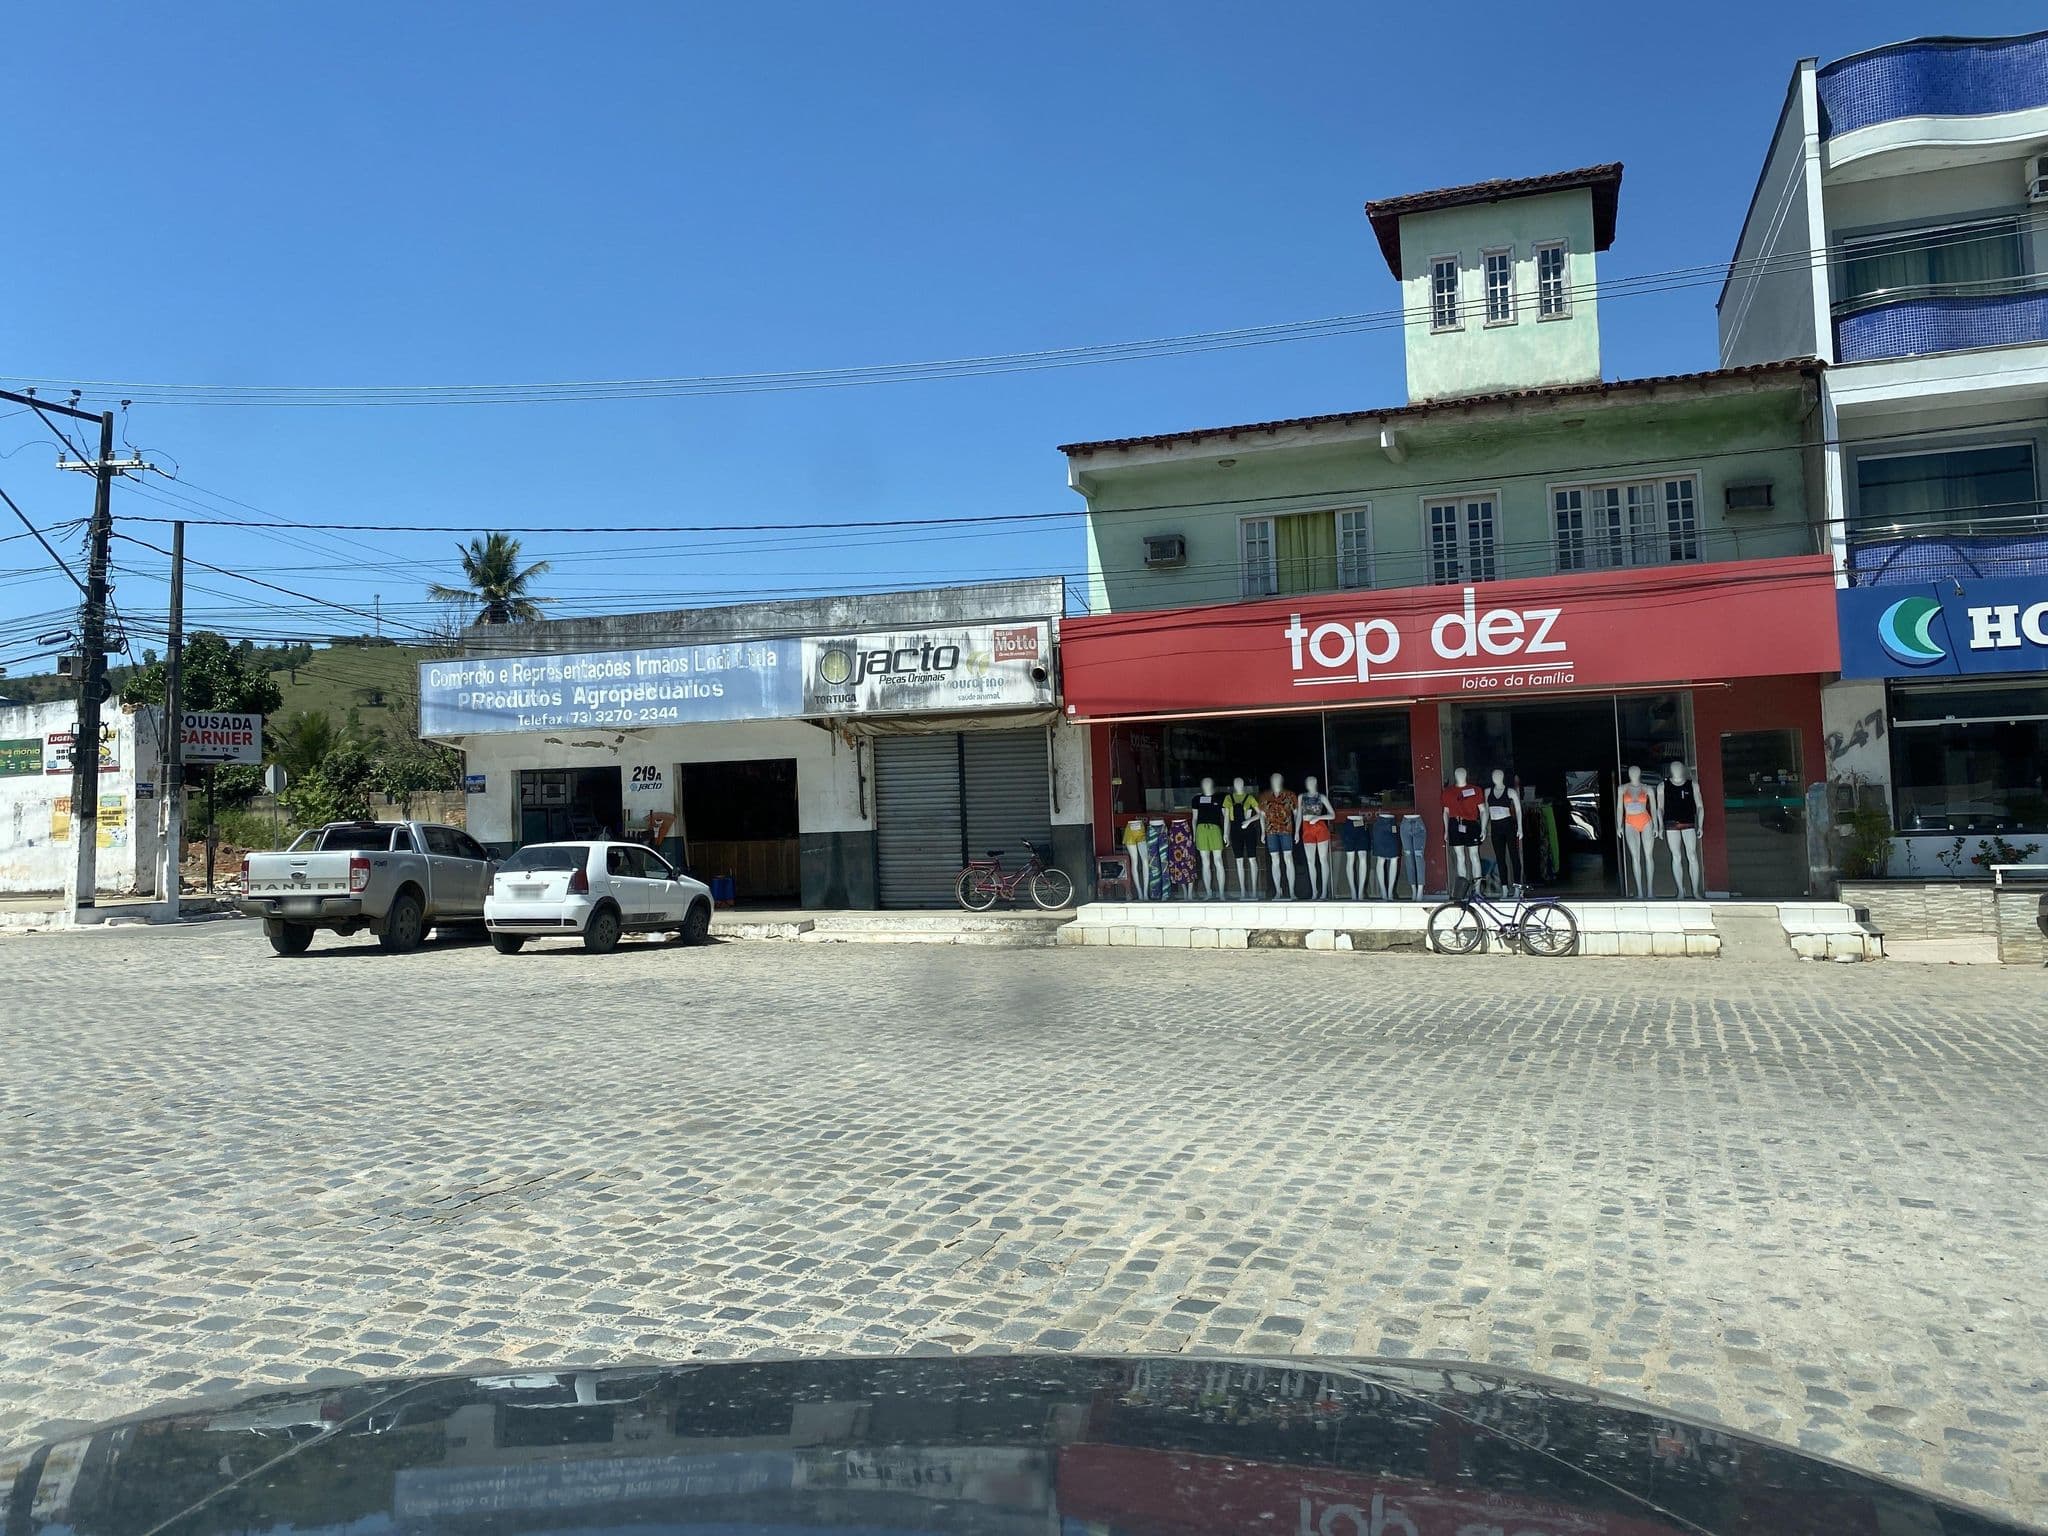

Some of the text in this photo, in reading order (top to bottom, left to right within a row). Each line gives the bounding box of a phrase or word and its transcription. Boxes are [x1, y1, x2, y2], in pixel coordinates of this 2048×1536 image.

[995, 635, 1036, 651] Motto
[1285, 587, 1567, 683] top dez
[500, 669, 508, 683] e
[512, 658, 631, 686] Representações
[636, 655, 688, 675] Irmãos
[850, 641, 960, 686] jacto
[879, 671, 946, 685] Peças Originais
[1462, 672, 1574, 689] lojão da família
[814, 693, 857, 704] TORTUGA
[518, 706, 678, 726] Telefax (73) 3270-2344
[250, 883, 347, 891] RANGER
